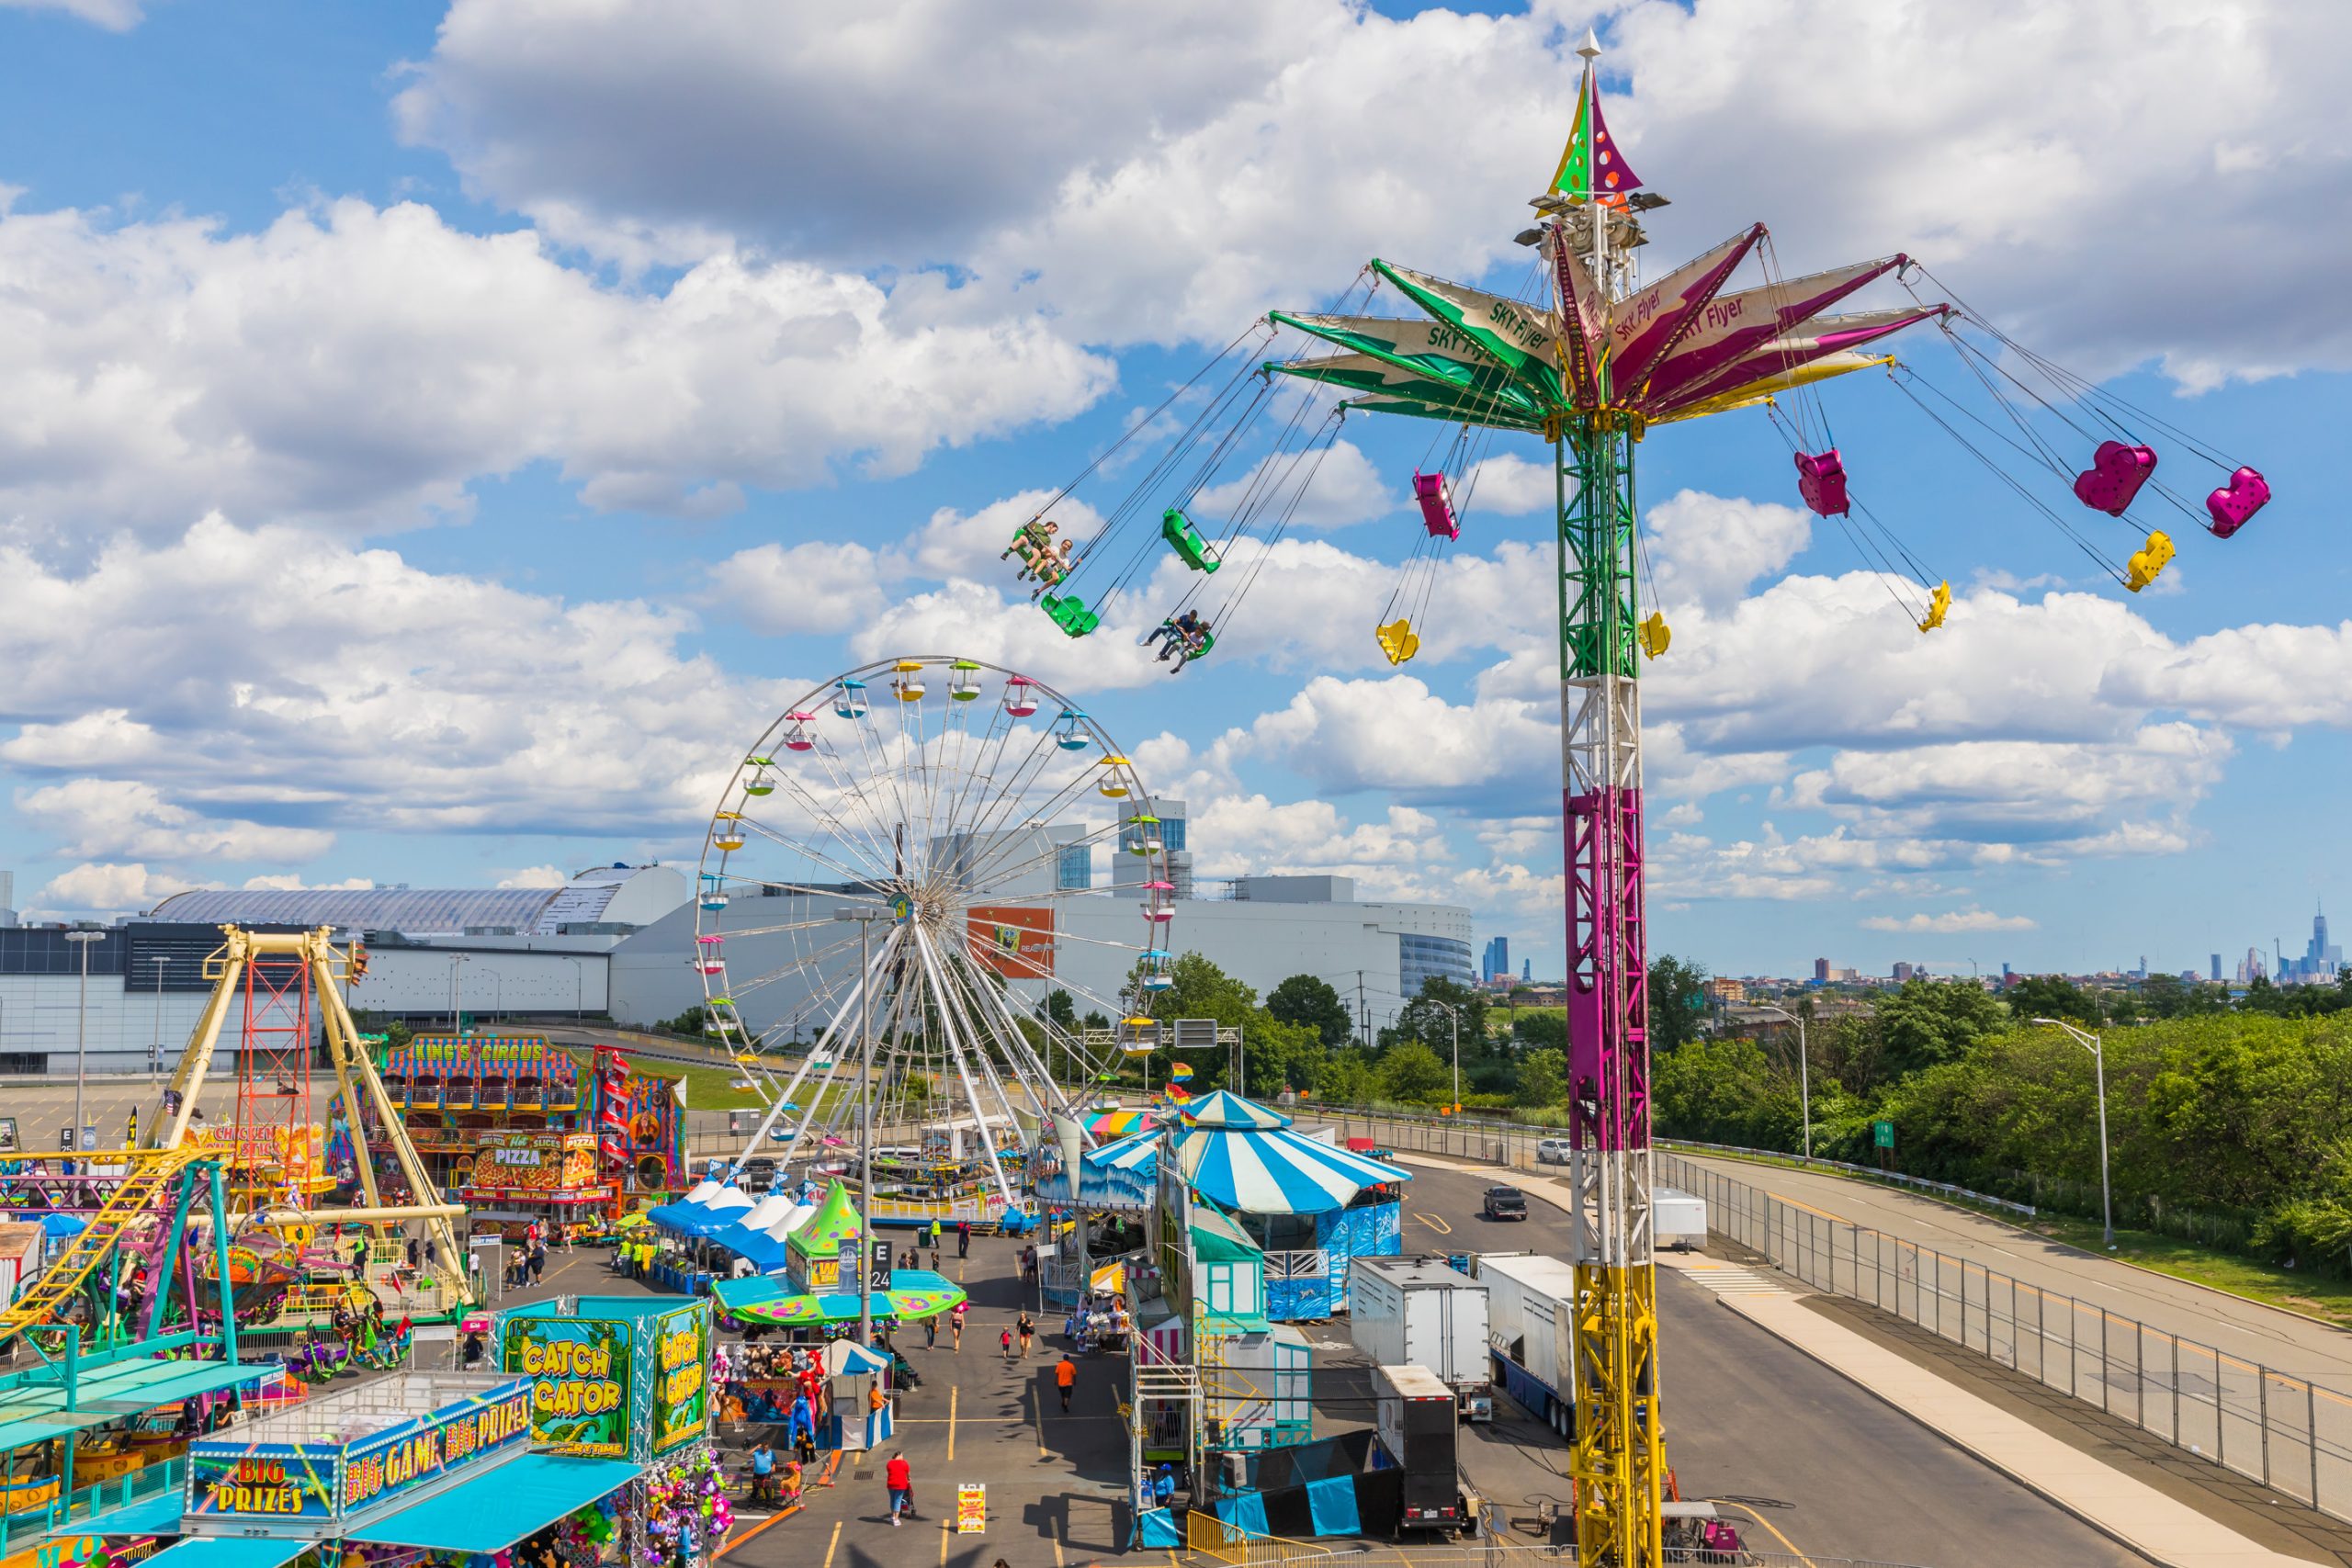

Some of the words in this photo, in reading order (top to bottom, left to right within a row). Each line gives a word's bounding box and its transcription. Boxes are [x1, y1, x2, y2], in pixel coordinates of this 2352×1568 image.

[1614, 311, 1634, 341] SKY
[1637, 288, 1660, 325] Flyer
[1706, 298, 1743, 328] Flyer
[1489, 302, 1518, 330] SKY
[1513, 319, 1549, 350] Flyer
[1428, 327, 1459, 351] SKY
[415, 1044, 470, 1061] KING'S
[481, 1044, 543, 1061] CIRCUS
[63, 1131, 71, 1140] E
[509, 1135, 530, 1148] Hot
[533, 1139, 561, 1148] SLICES
[567, 1139, 595, 1148] PIZZA
[495, 1149, 540, 1166] PIZZA
[582, 1190, 600, 1198] PIZZA
[876, 1245, 887, 1260] E
[872, 1271, 889, 1286] 24
[522, 1339, 612, 1379] CATCH
[661, 1330, 698, 1372] CATCH
[657, 1379, 665, 1404] A
[666, 1362, 704, 1407] GATOR
[534, 1380, 622, 1418] GATOR
[346, 1452, 384, 1506] BIG
[385, 1428, 440, 1487] GAME
[446, 1415, 477, 1463] BIG
[477, 1393, 531, 1450] PRIZES
[238, 1458, 286, 1483] BIG
[218, 1485, 303, 1515] PRIZES
